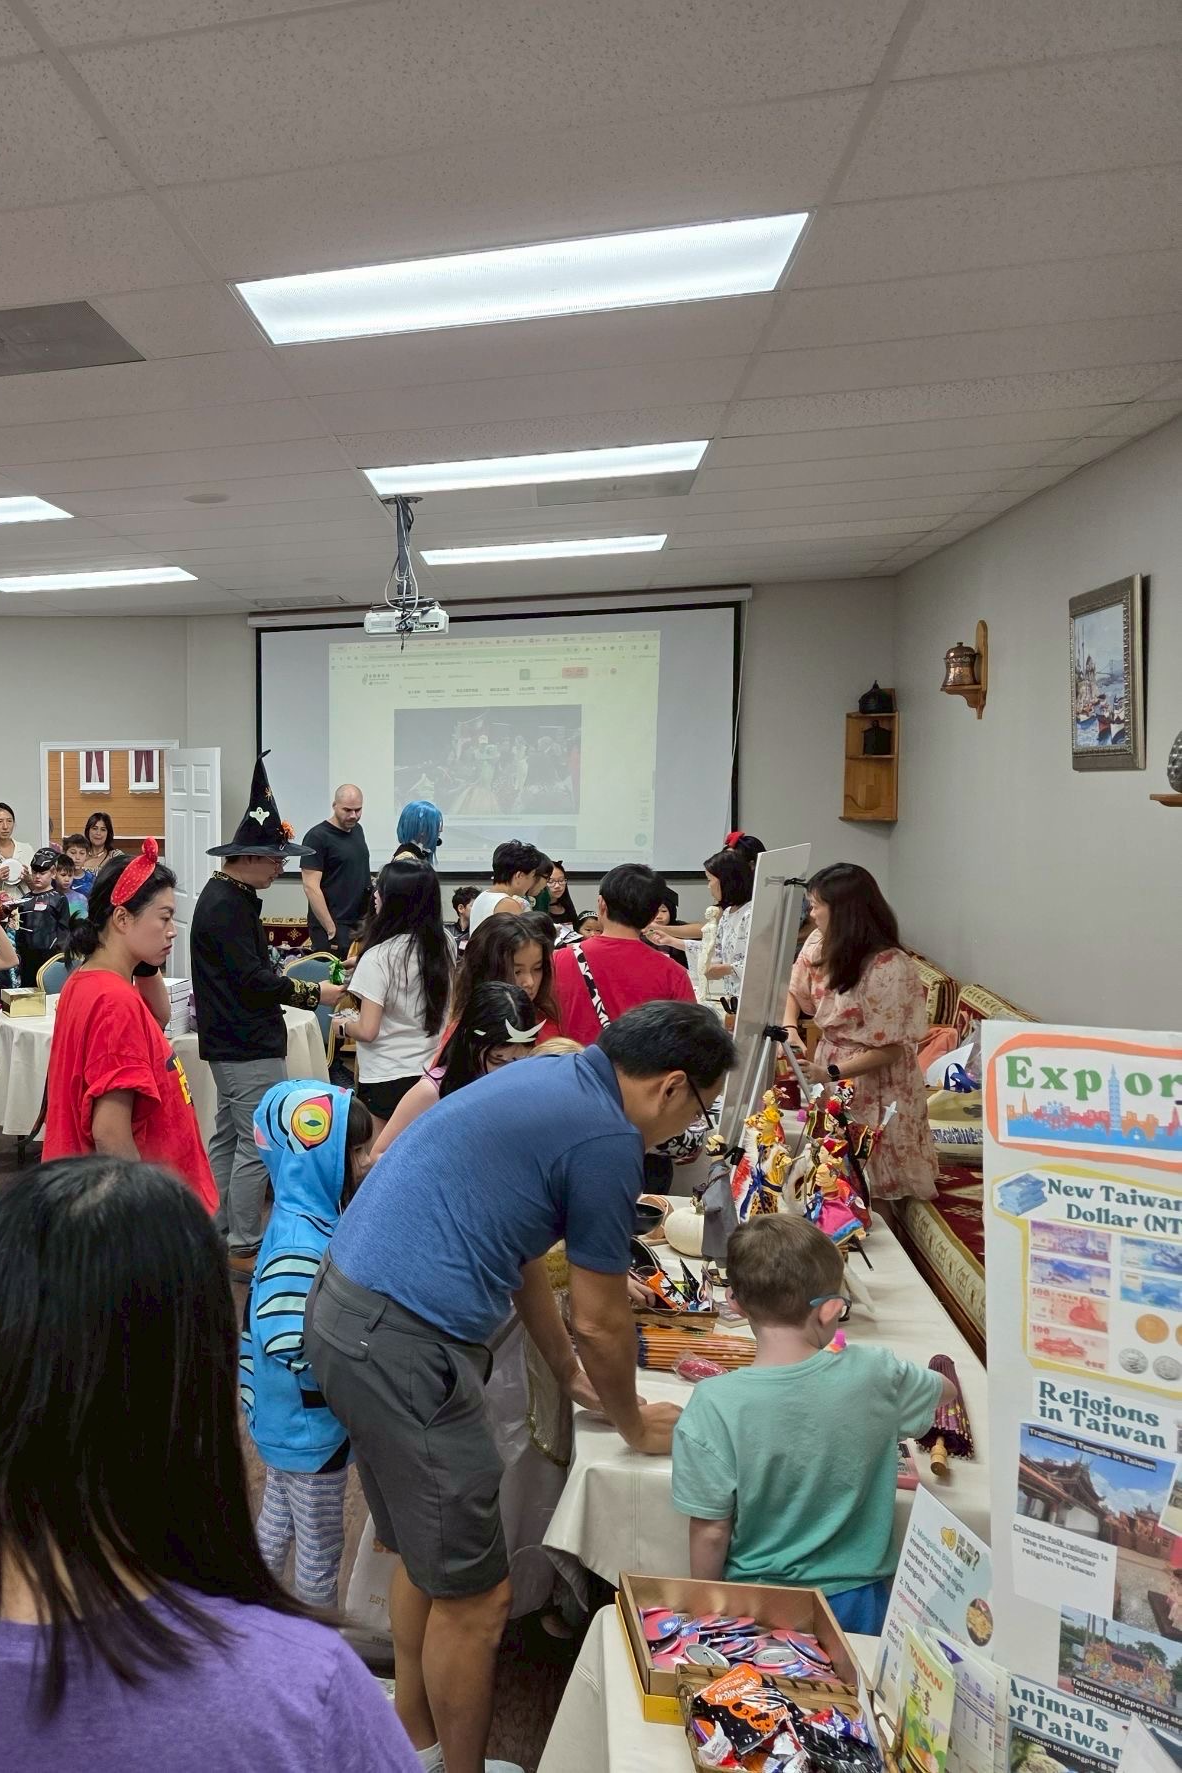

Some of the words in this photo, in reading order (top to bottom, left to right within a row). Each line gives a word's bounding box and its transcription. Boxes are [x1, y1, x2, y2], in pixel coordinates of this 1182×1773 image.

[1048, 1178, 1095, 1200] New
[1067, 1203, 1139, 1228] Dollar
[1039, 1381, 1160, 1427] Religions
[1039, 1399, 1063, 1422] in
[1069, 1408, 1167, 1450] Taiwan
[1029, 1427, 1076, 1449] Traditional
[1076, 1441, 1111, 1459] Temple
[1111, 1450, 1122, 1462] in
[1123, 1453, 1157, 1471] Taiwan
[1013, 1523, 1046, 1541] Chinese
[1047, 1535, 1065, 1548] folk
[1065, 1542, 1099, 1560] religion
[1101, 1553, 1109, 1562] is
[1023, 1537, 1037, 1548] the
[1038, 1543, 1061, 1556] most
[1062, 1551, 1097, 1568] popular
[906, 1548, 923, 1569] market
[929, 1555, 942, 1572] from
[1022, 1547, 1054, 1564] religion
[1055, 1558, 1064, 1567] in
[1065, 1561, 1097, 1578] Taiwan
[904, 1582, 918, 1600] There
[1010, 1677, 1109, 1732] Animals
[1072, 1678, 1113, 1700] Taiwanese
[1114, 1693, 1145, 1711] Puppet
[1145, 1705, 1169, 1720] Show
[1074, 1687, 1116, 1710] Taiwanese
[1017, 1731, 1053, 1749] Formosan
[1053, 1744, 1069, 1756] blue
[1069, 1752, 1097, 1768] magpie
